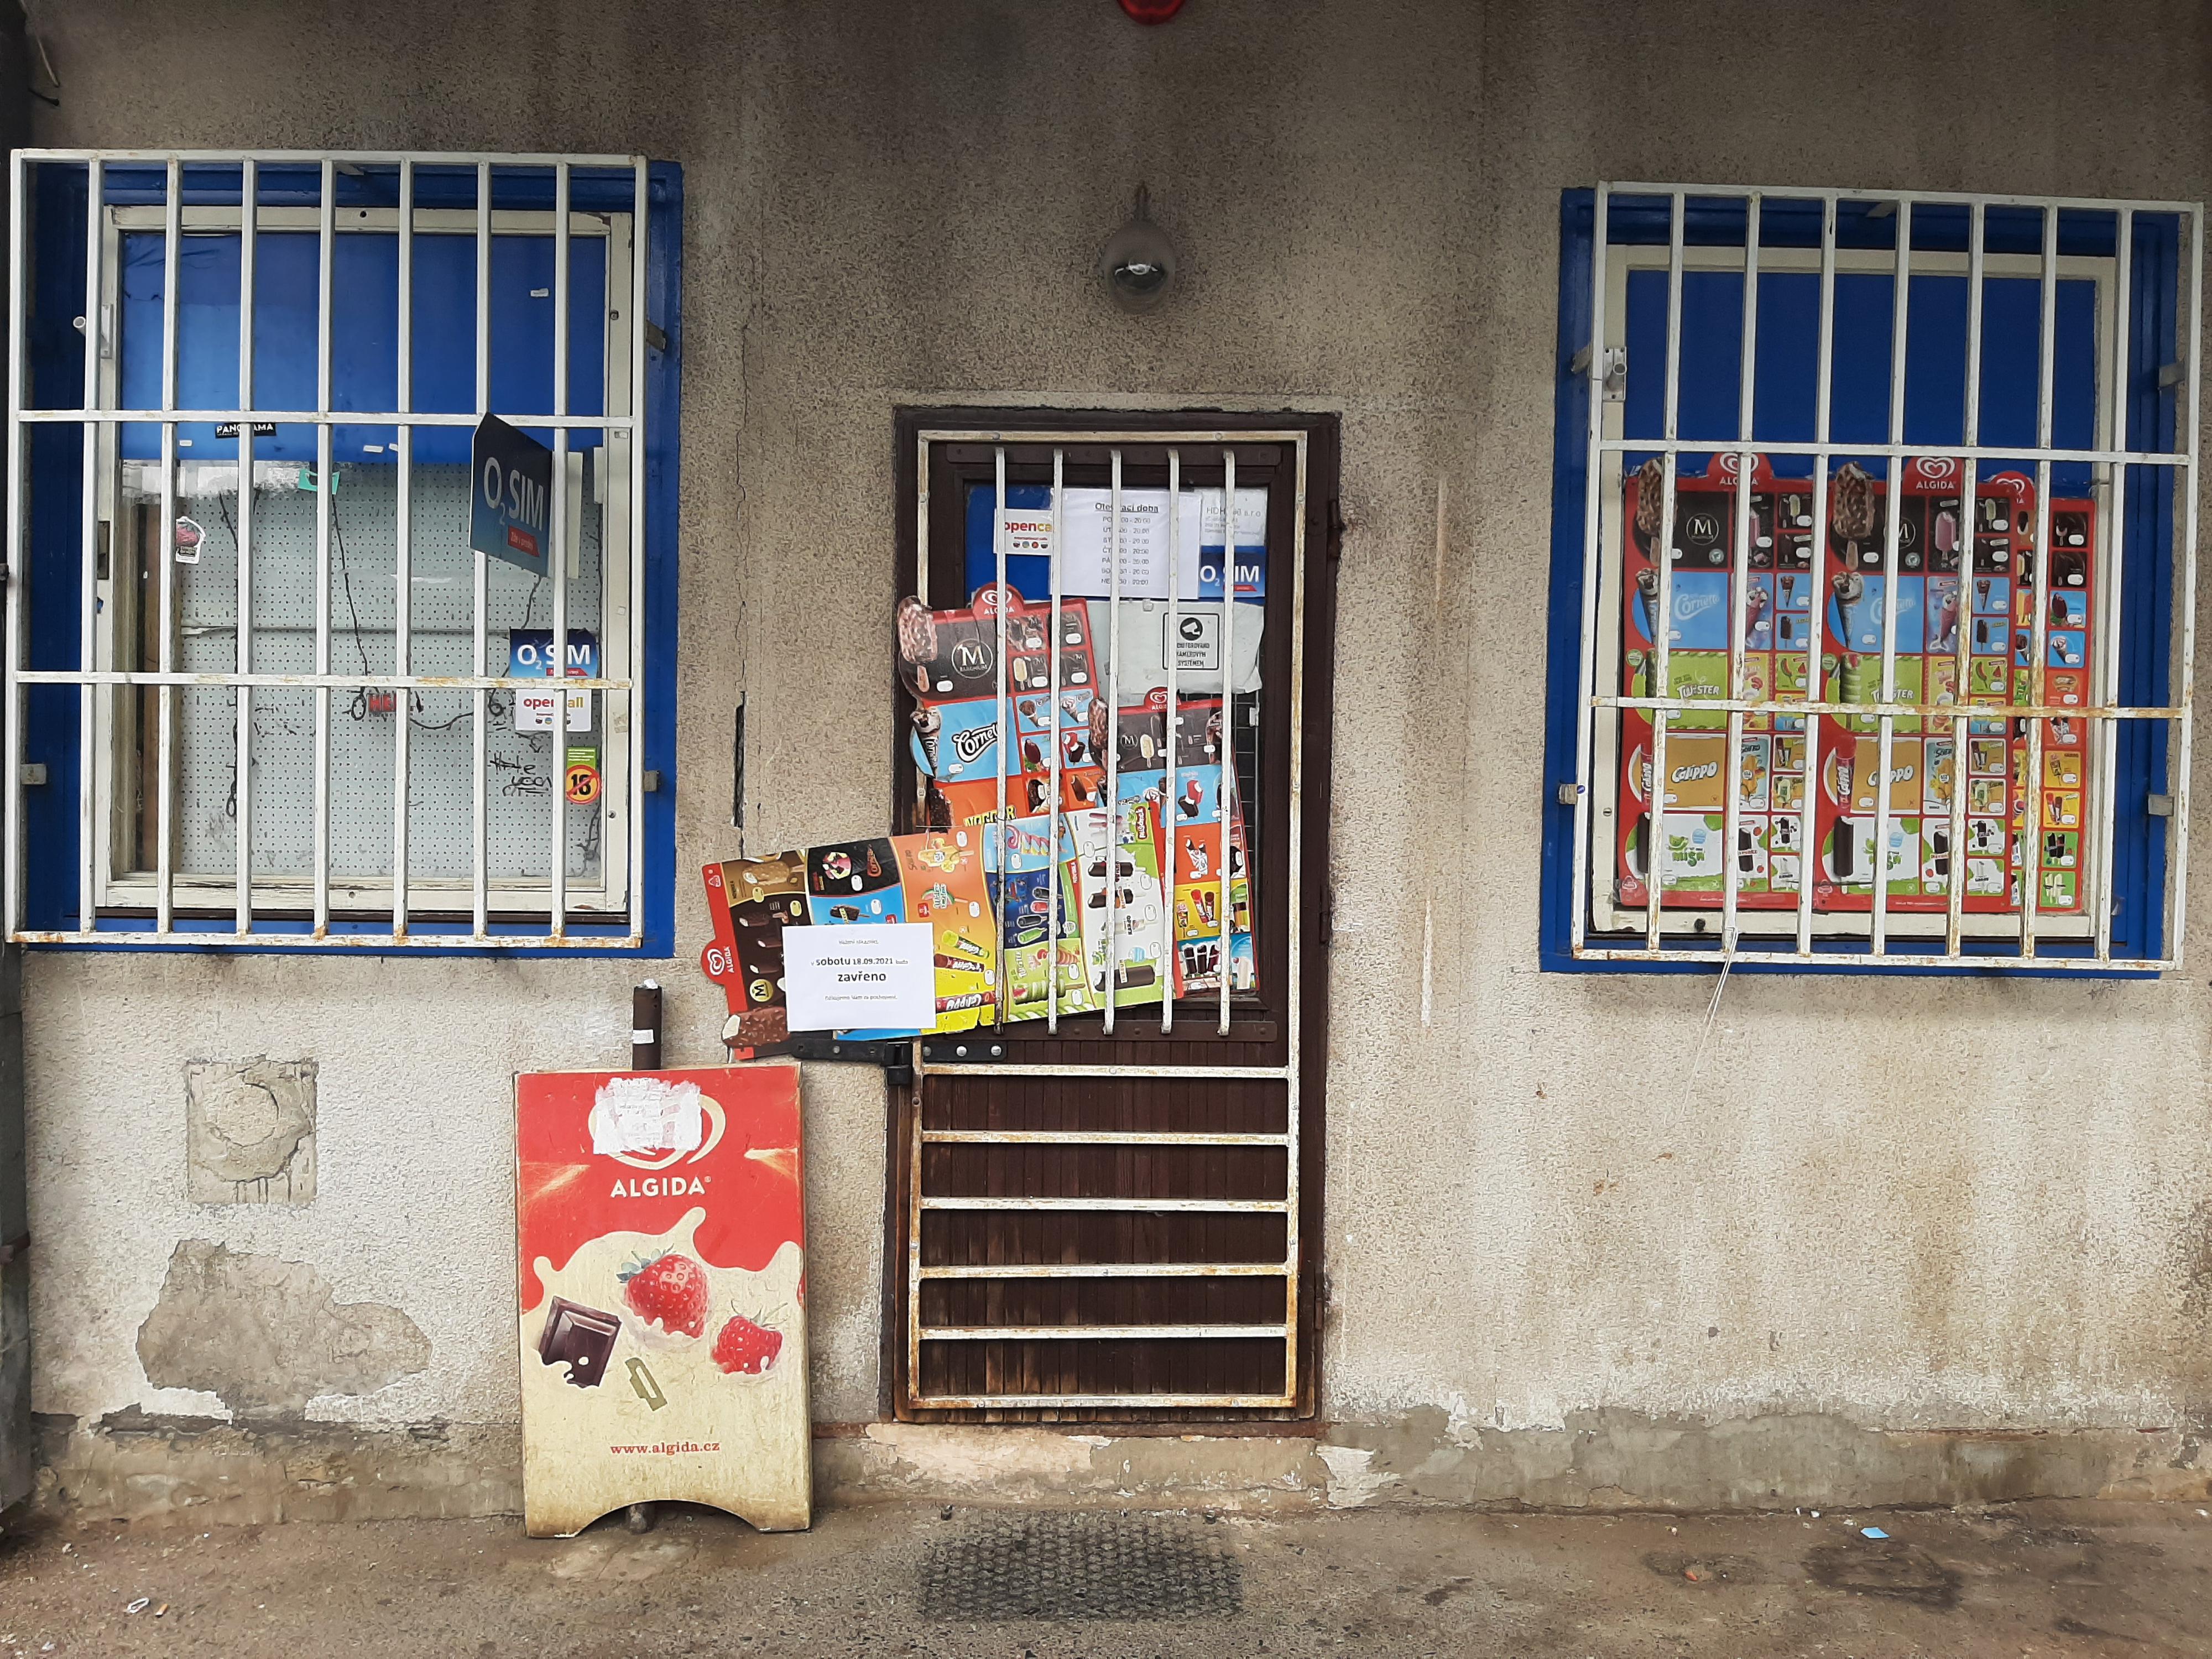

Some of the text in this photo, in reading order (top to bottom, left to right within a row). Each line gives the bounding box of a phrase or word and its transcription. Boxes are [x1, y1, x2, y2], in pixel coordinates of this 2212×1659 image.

[216, 424, 274, 434] PANOAMA
[1719, 477, 1758, 485] ALGA
[1916, 481, 1955, 489] ALGIDA
[509, 469, 544, 531] SIM
[1694, 519, 1712, 535] M
[545, 644, 591, 665] SM
[523, 697, 583, 709] opeall
[963, 805, 1016, 827] NOGGR
[723, 946, 735, 973] ALGIDA
[816, 957, 851, 966] sobotu
[837, 971, 887, 982] zavřeno
[610, 1177, 706, 1198] ALGIDA
[611, 1441, 721, 1456] www.algida.cz
